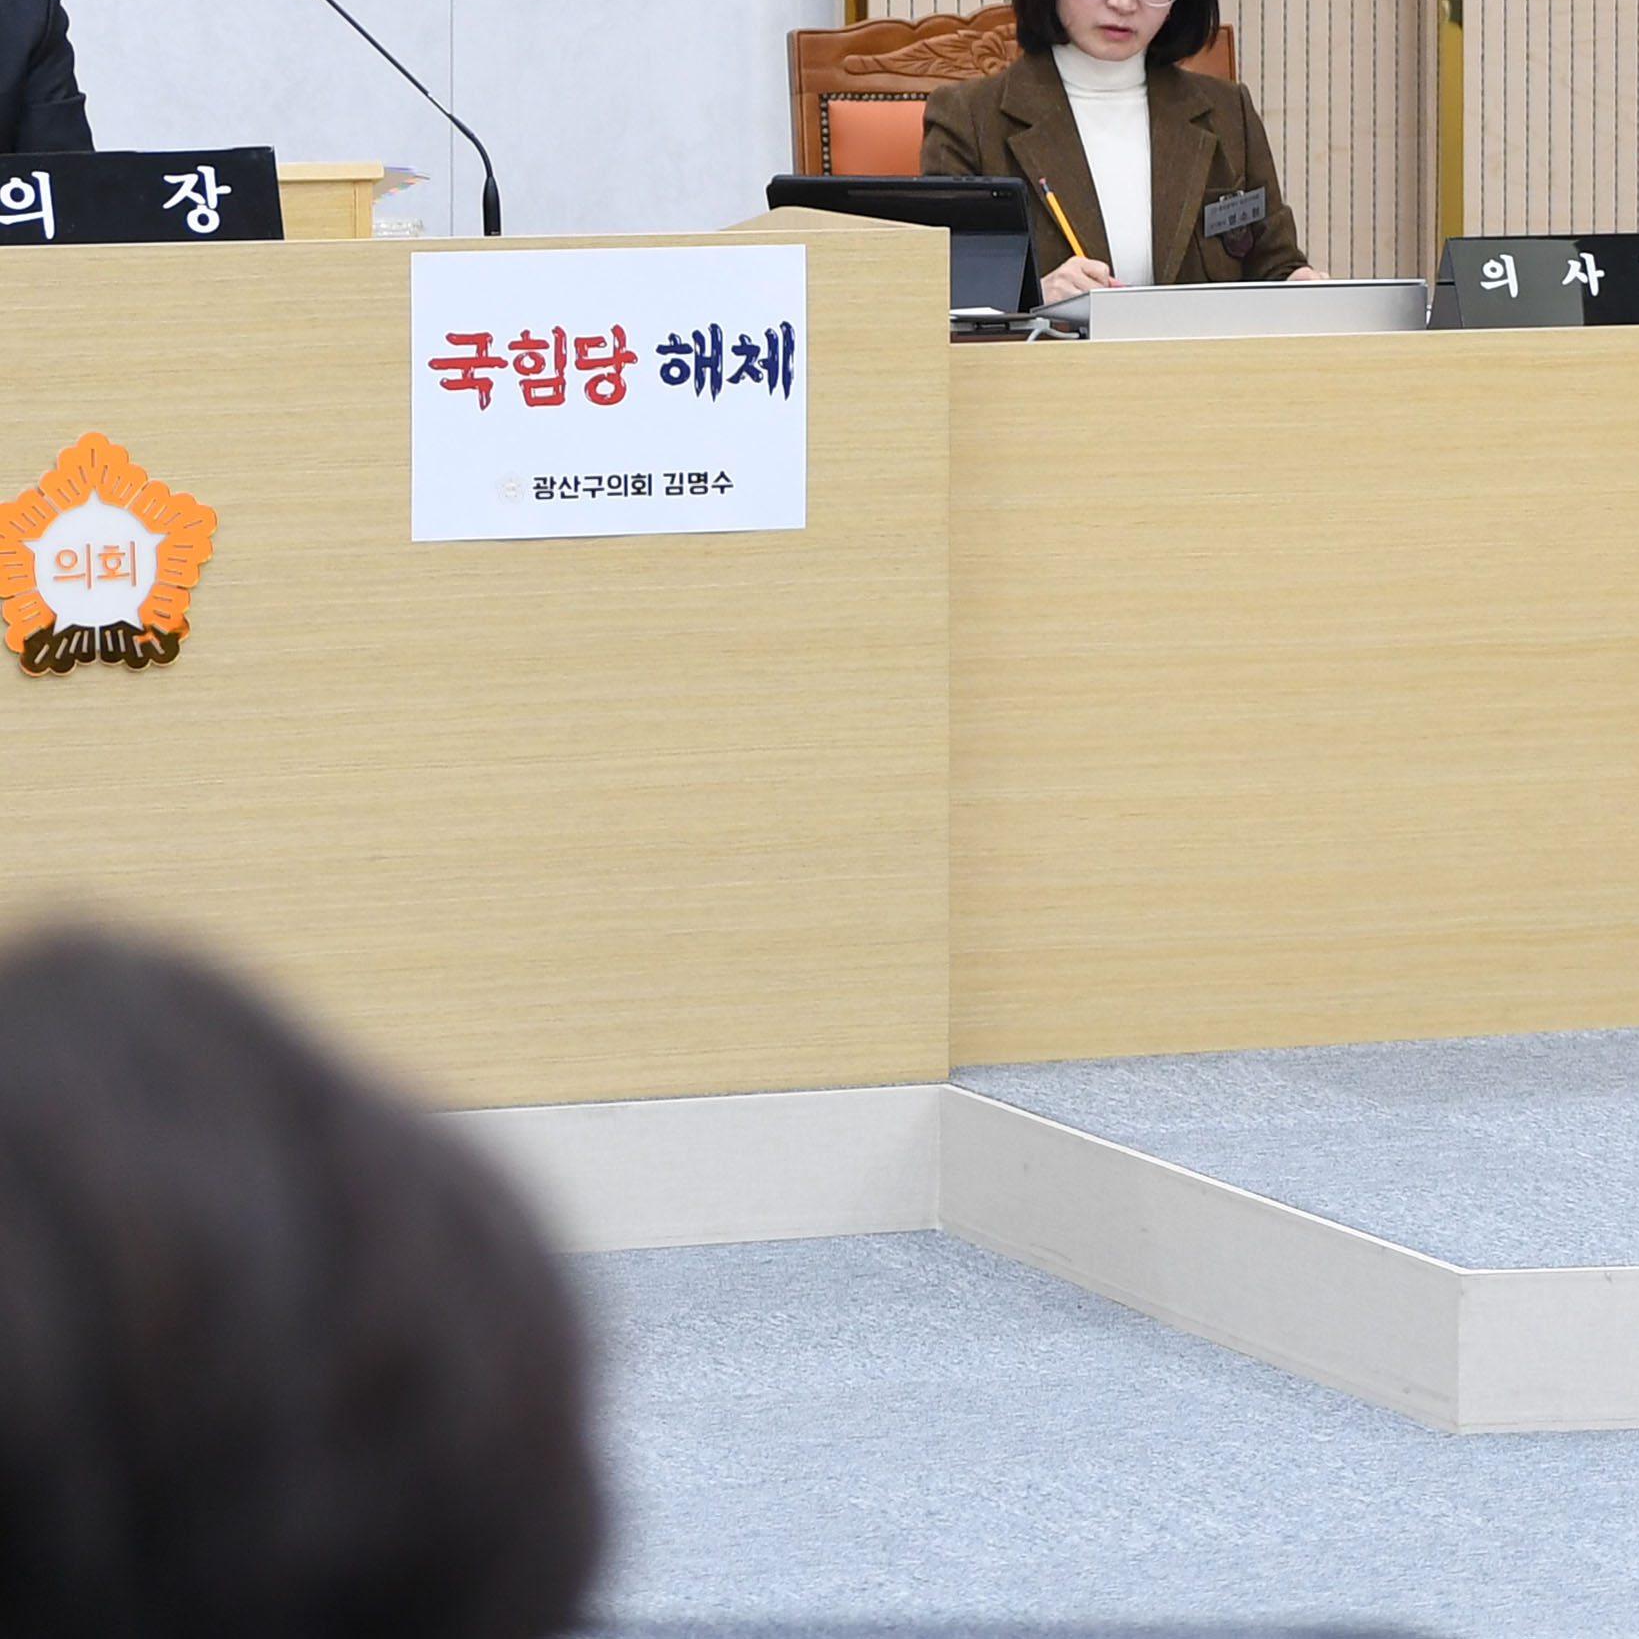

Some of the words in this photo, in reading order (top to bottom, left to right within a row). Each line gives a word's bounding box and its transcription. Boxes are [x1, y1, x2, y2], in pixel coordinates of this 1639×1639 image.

[427, 323, 639, 411] 국힘당
[655, 319, 797, 403] 해체
[531, 472, 654, 501] 광산구의회
[662, 470, 735, 497] 김명수
[53, 540, 137, 590] 의회
